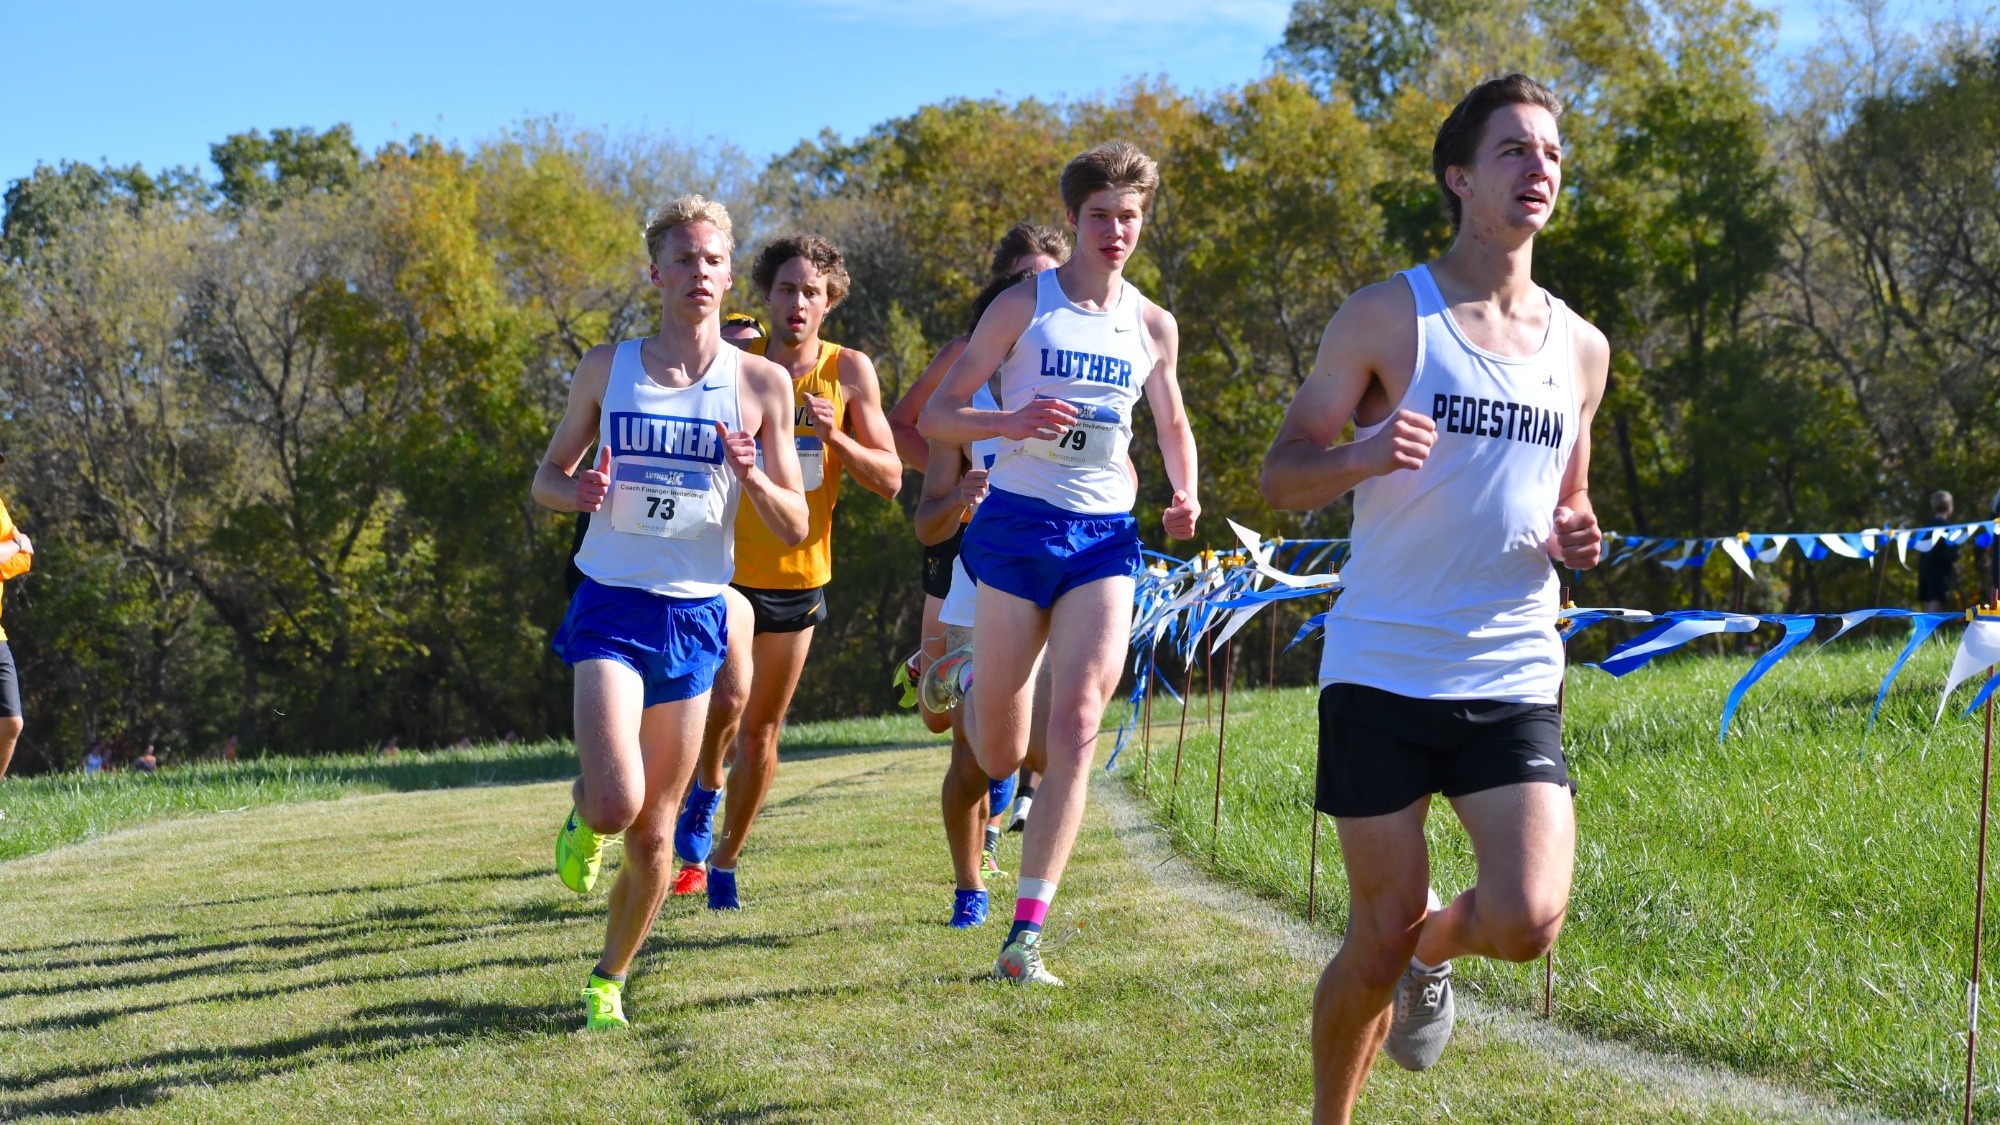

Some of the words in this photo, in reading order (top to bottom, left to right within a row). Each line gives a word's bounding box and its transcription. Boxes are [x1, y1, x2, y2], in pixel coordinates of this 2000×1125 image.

[1040, 348, 1132, 388] LUTHER
[1082, 422, 1114, 431] Invitational
[1432, 393, 1564, 449] PEDESTRIAN
[618, 416, 716, 459] LUTHER
[1059, 429, 1087, 451] 79
[645, 471, 668, 482] LUTHER
[620, 483, 641, 492] Coach
[641, 486, 670, 495] Finanger
[670, 489, 705, 499] Invitational
[646, 496, 676, 520] 73
